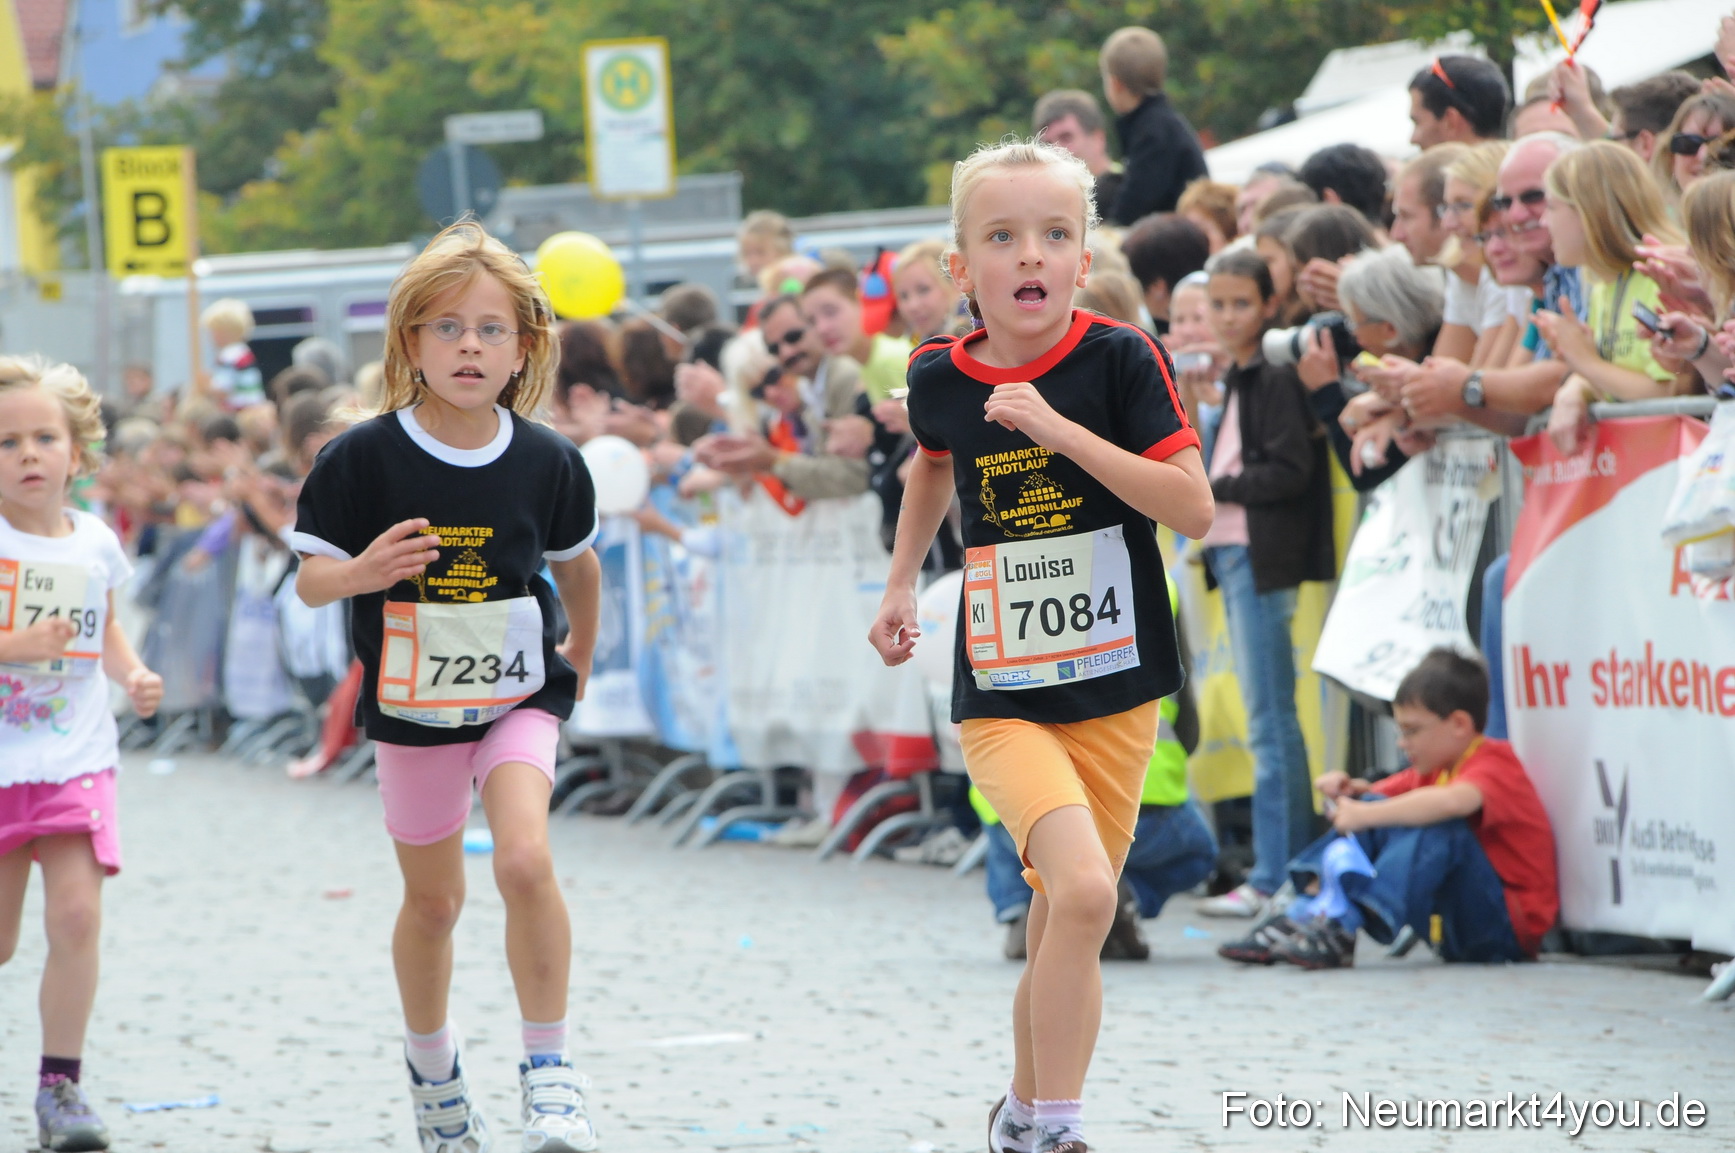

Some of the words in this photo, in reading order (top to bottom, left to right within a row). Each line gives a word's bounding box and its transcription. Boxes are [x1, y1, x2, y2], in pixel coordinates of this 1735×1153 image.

[134, 192, 170, 246] B
[982, 457, 1049, 478] STADTLAUF
[1000, 497, 1084, 521] BAMBINILAUF
[439, 537, 486, 547] ADTLAUF
[24, 568, 54, 592] Eva
[1003, 555, 1075, 583] Louisa
[428, 576, 499, 588] BAMBINILAUF
[1010, 586, 1121, 640] 7084
[429, 650, 529, 687] 7234
[1076, 645, 1136, 669] PFLEIDERER
[989, 670, 1031, 682] BOCK
[1513, 644, 1570, 708] Ihr
